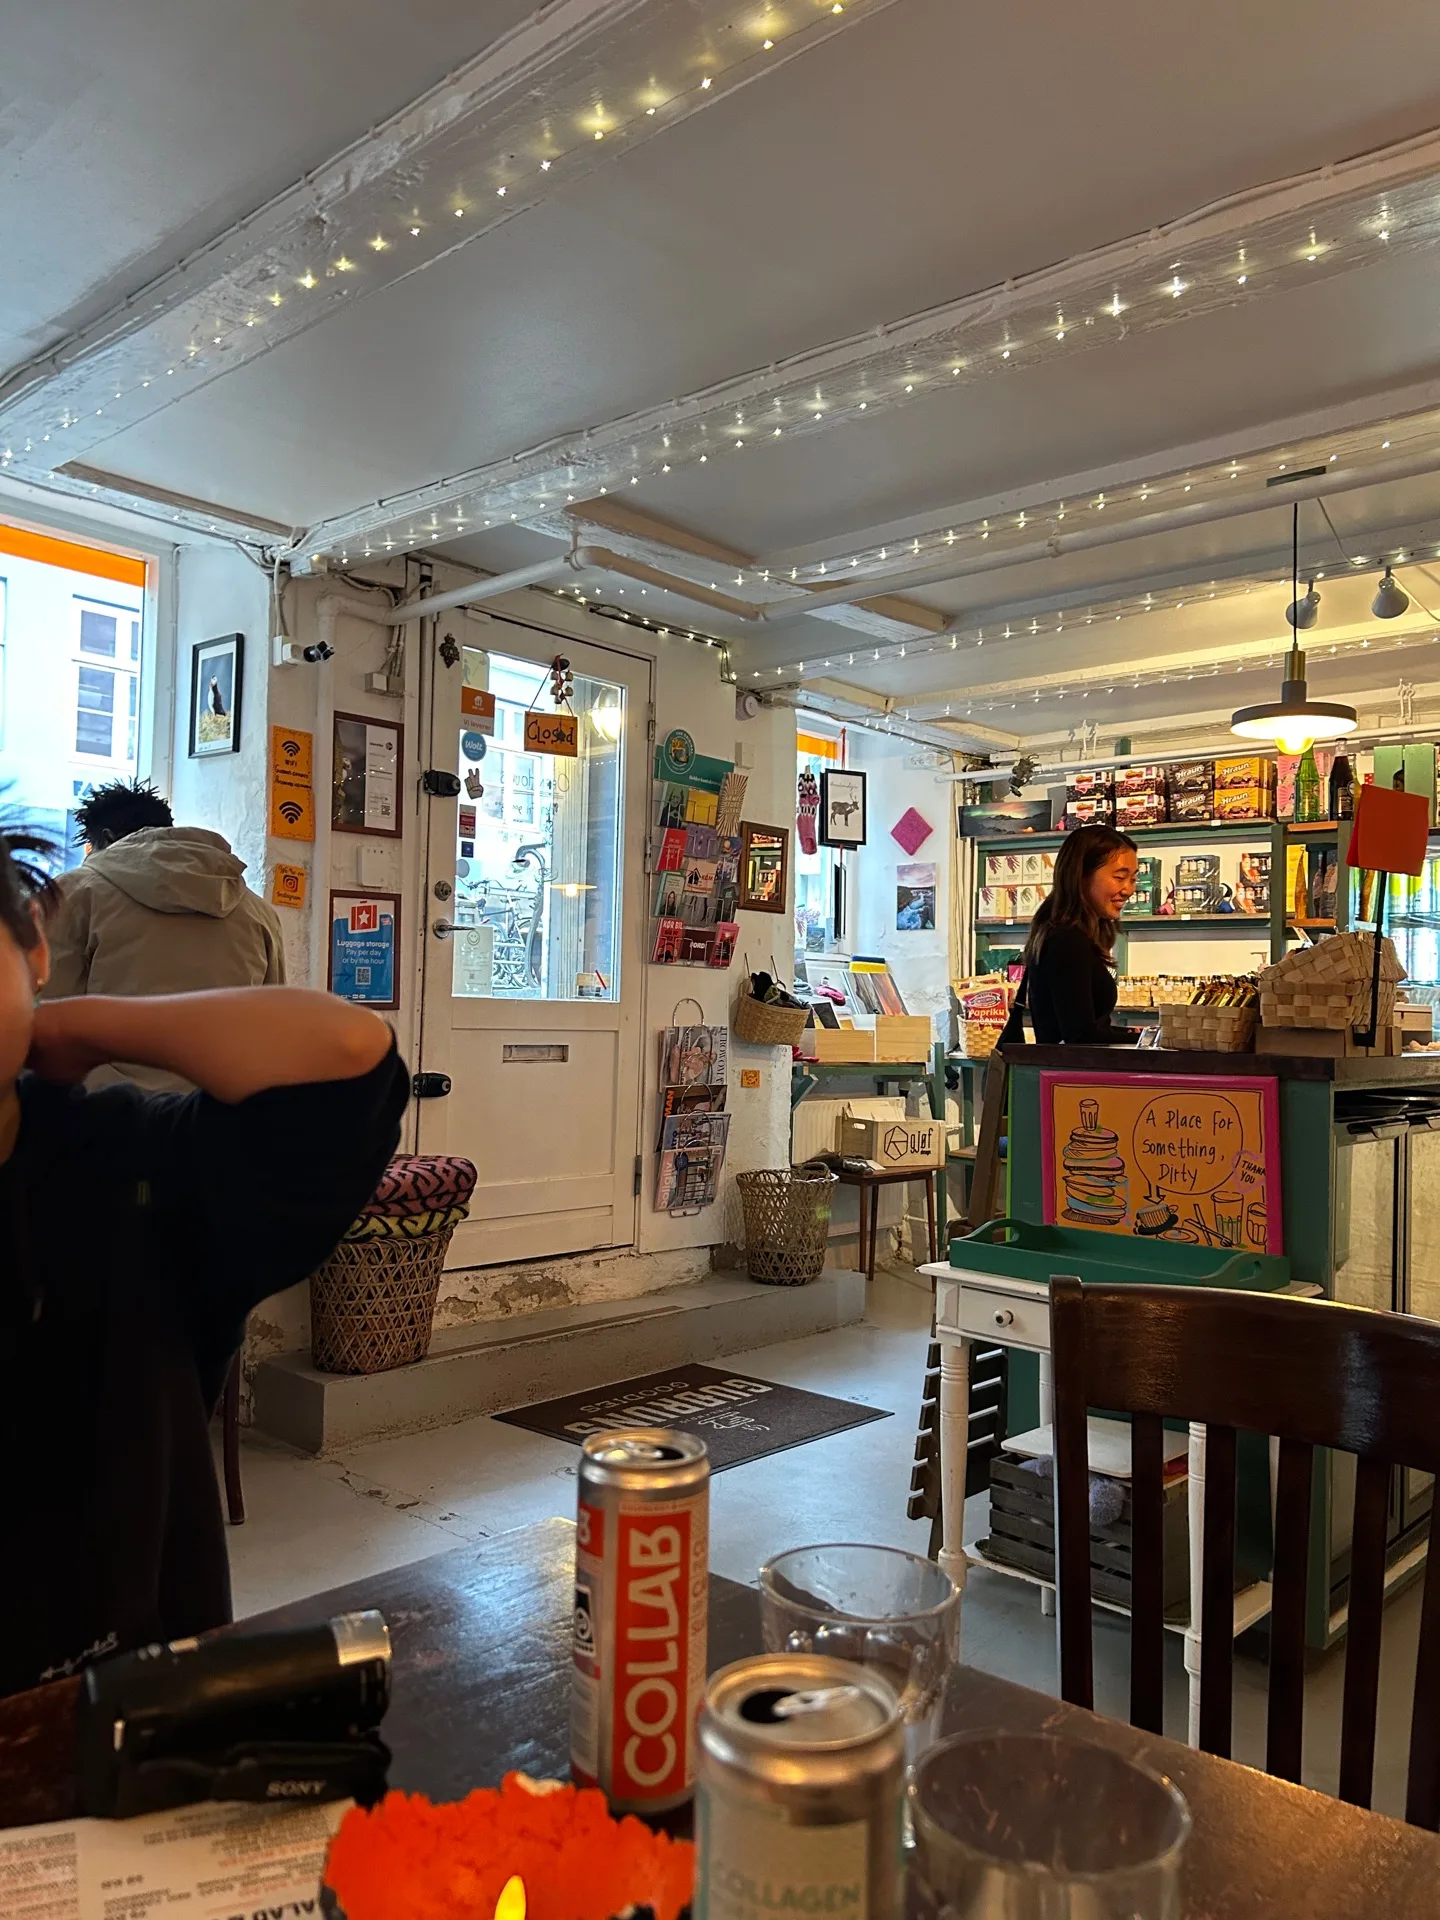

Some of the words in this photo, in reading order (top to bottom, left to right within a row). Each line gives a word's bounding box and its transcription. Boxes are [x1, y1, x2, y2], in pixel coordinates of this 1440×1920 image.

[1175, 765, 1205, 780] Hraun
[1222, 762, 1250, 775] Hraun
[1176, 793, 1206, 809] Hraun
[1221, 792, 1248, 806] Hraun
[337, 939, 365, 949] Luggage
[366, 941, 390, 949] storage
[968, 1008, 1004, 1020] Papriku
[715, 1026, 727, 1084] EUROWOMA
[1146, 1109, 1156, 1128] A
[1165, 1109, 1202, 1130] Place
[1142, 1138, 1225, 1165] Something,
[1158, 1163, 1198, 1192] Dirty
[1240, 1171, 1255, 1184] YOU
[579, 1381, 690, 1414] GOODIES
[624, 1525, 681, 1787] COLLAB
[266, 1782, 326, 1798] SONY
